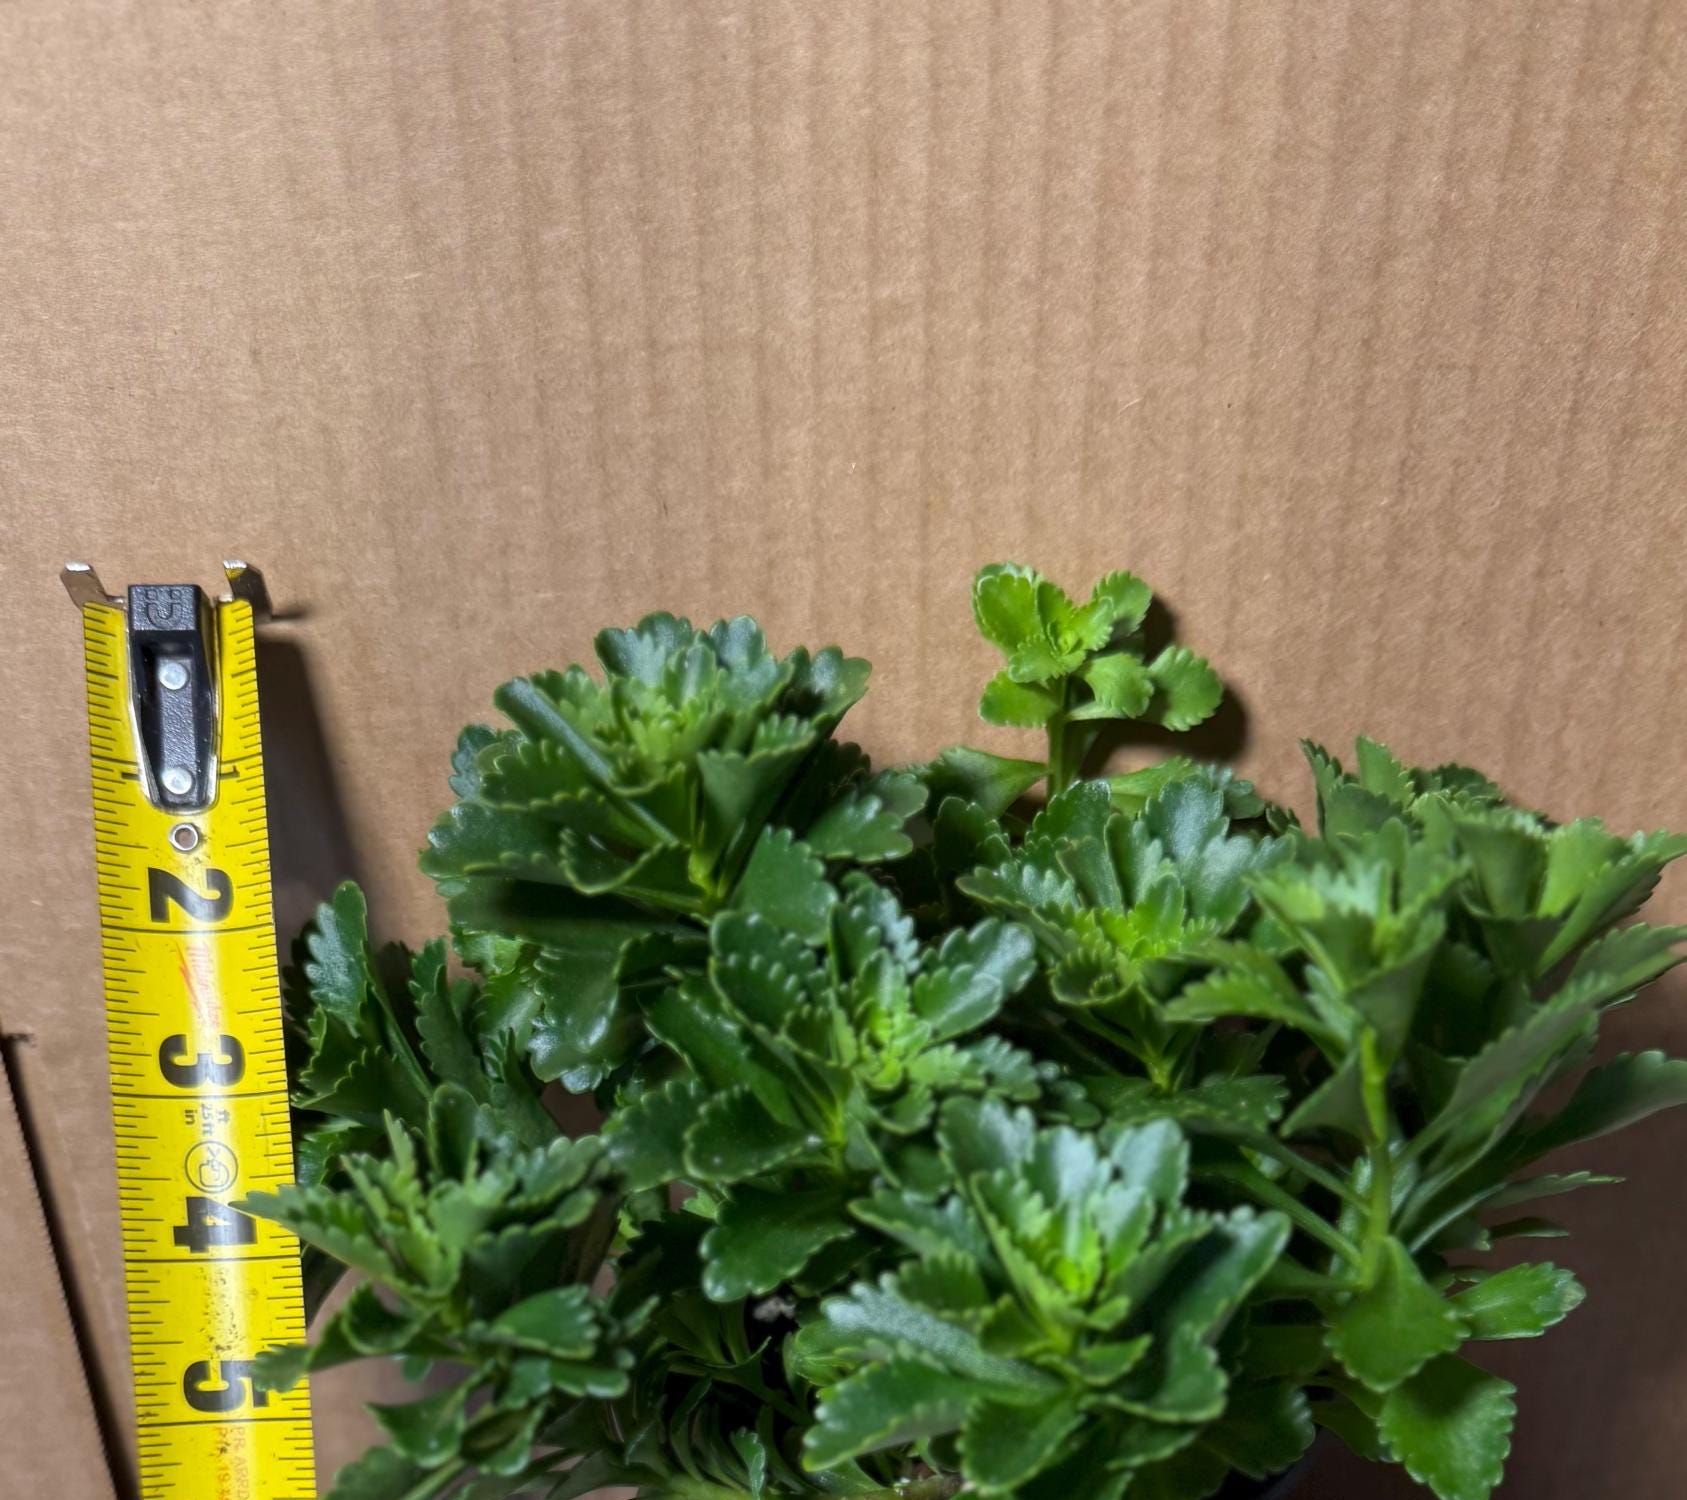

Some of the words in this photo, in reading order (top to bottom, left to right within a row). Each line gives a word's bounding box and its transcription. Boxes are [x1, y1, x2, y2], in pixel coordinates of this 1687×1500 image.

[147, 866, 234, 923] 2
[158, 1033, 246, 1089] 3
[184, 1109, 198, 1125] in
[173, 1196, 258, 1253] 4
[183, 1360, 270, 1413] 5
